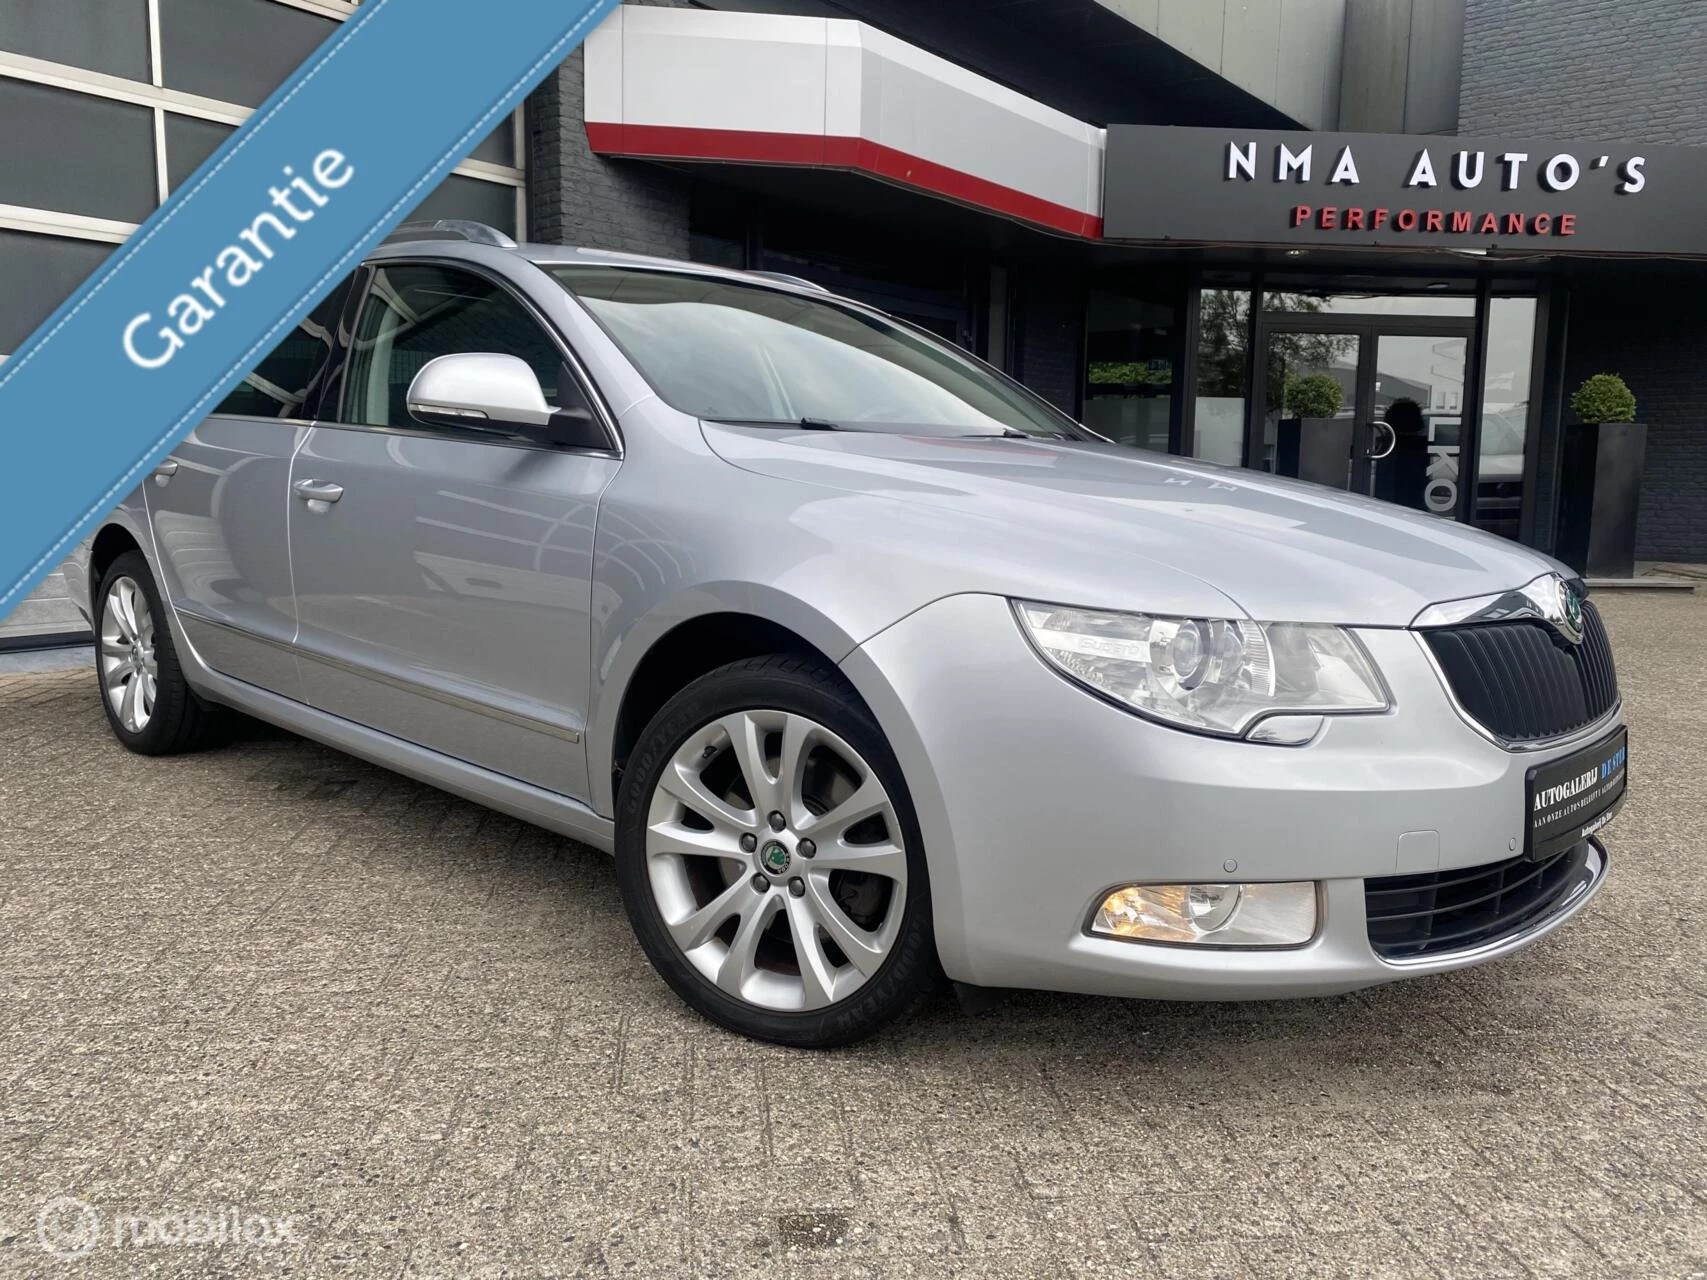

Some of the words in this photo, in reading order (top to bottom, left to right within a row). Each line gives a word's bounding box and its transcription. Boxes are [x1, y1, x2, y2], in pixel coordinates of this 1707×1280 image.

[1226, 141, 1361, 184] NMA
[1407, 147, 1647, 193] AUTO'S
[1293, 205, 1577, 236] PERFORMANCE
[1424, 338, 1467, 520] WELKO
[1534, 766, 1598, 812] AUTOGALERIJ
[1602, 758, 1611, 779] DE
